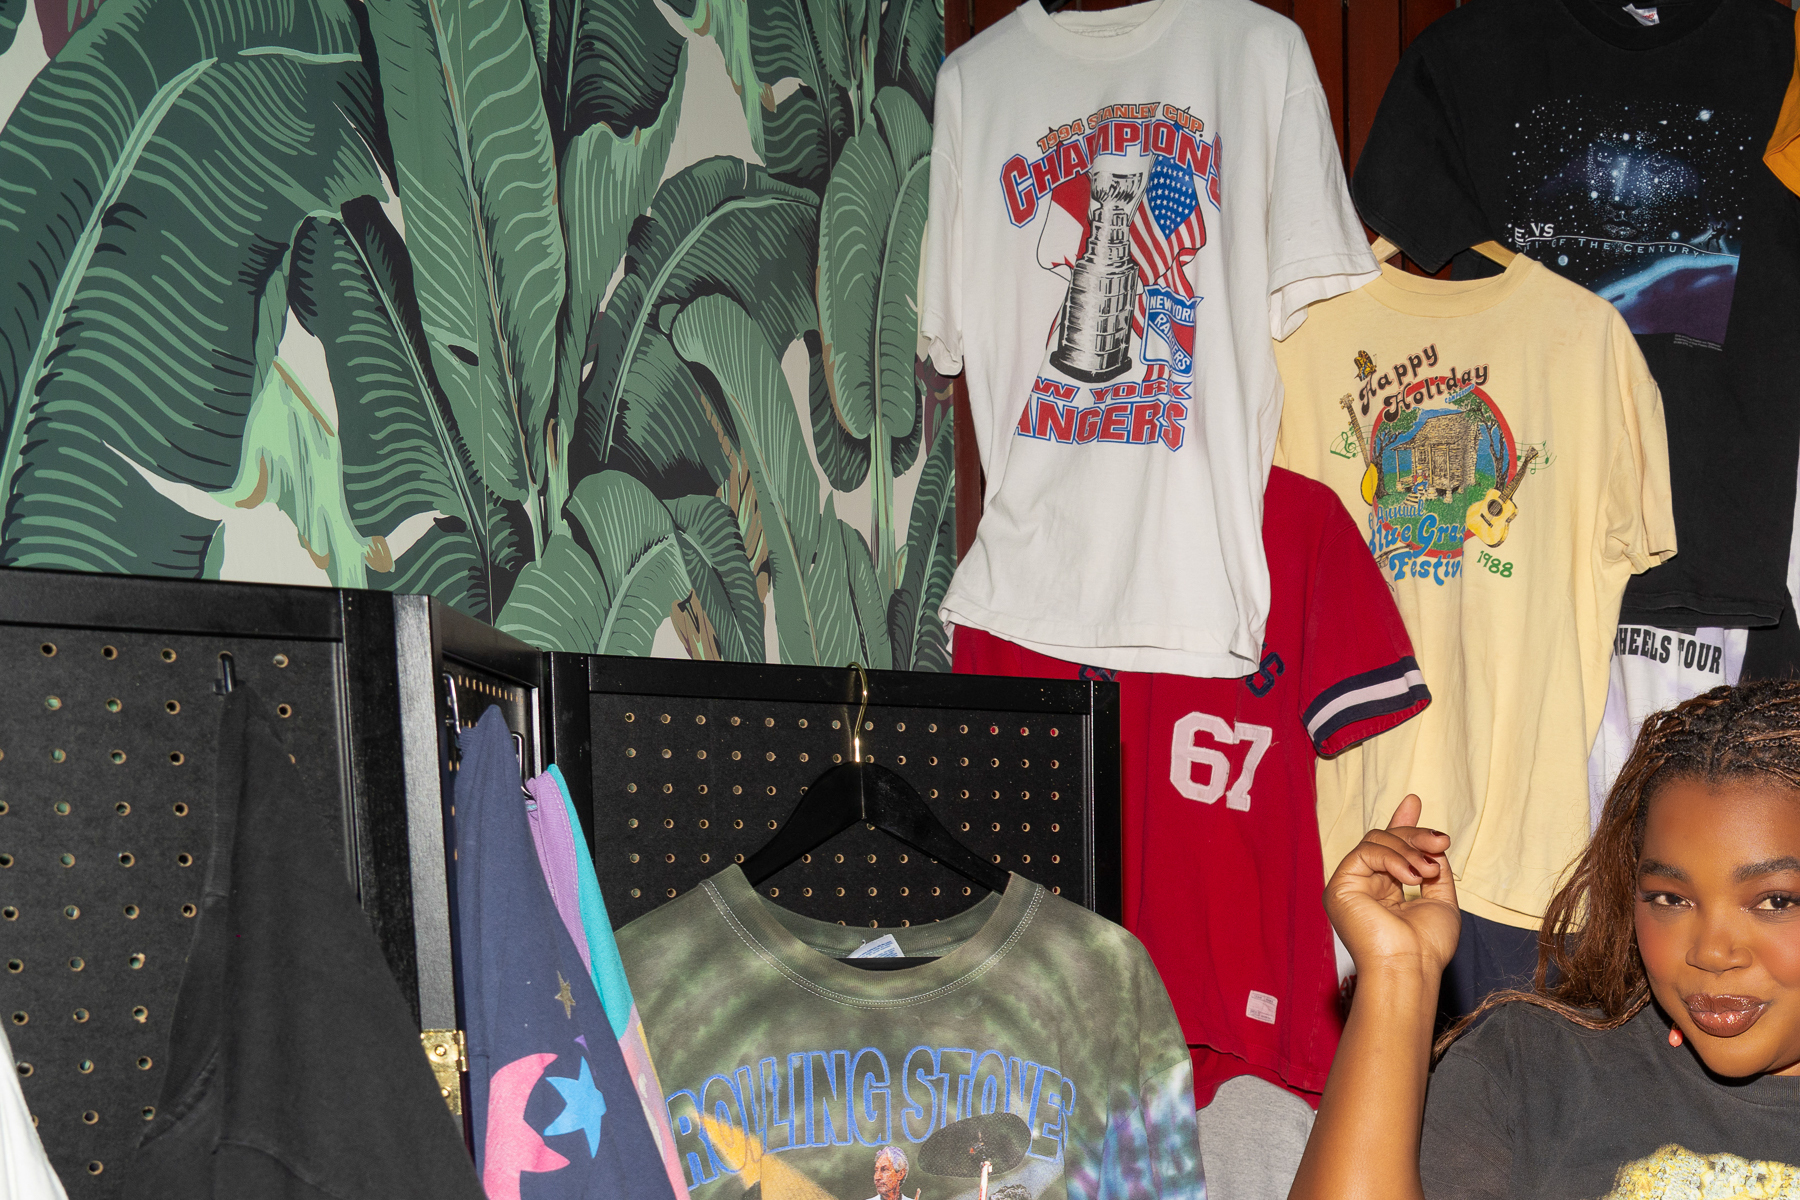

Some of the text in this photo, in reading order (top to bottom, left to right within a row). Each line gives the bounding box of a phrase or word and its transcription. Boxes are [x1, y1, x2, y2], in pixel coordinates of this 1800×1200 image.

[1037, 102, 1205, 155] 1994 STANLEY CUP
[1000, 118, 1223, 229] CHAMPIONS
[1578, 238, 1611, 250] THE
[1623, 243, 1700, 259] CENTURY
[1149, 295, 1172, 312] NEW
[1358, 343, 1439, 416] Happy
[1383, 363, 1490, 423] Holiday
[1013, 396, 1188, 453] ANGERS
[1376, 499, 1425, 525] Annual
[1476, 550, 1514, 578] 1988
[1677, 637, 1723, 675] TOUR
[1168, 710, 1273, 813] 67
[665, 1046, 891, 1192] ROLLING
